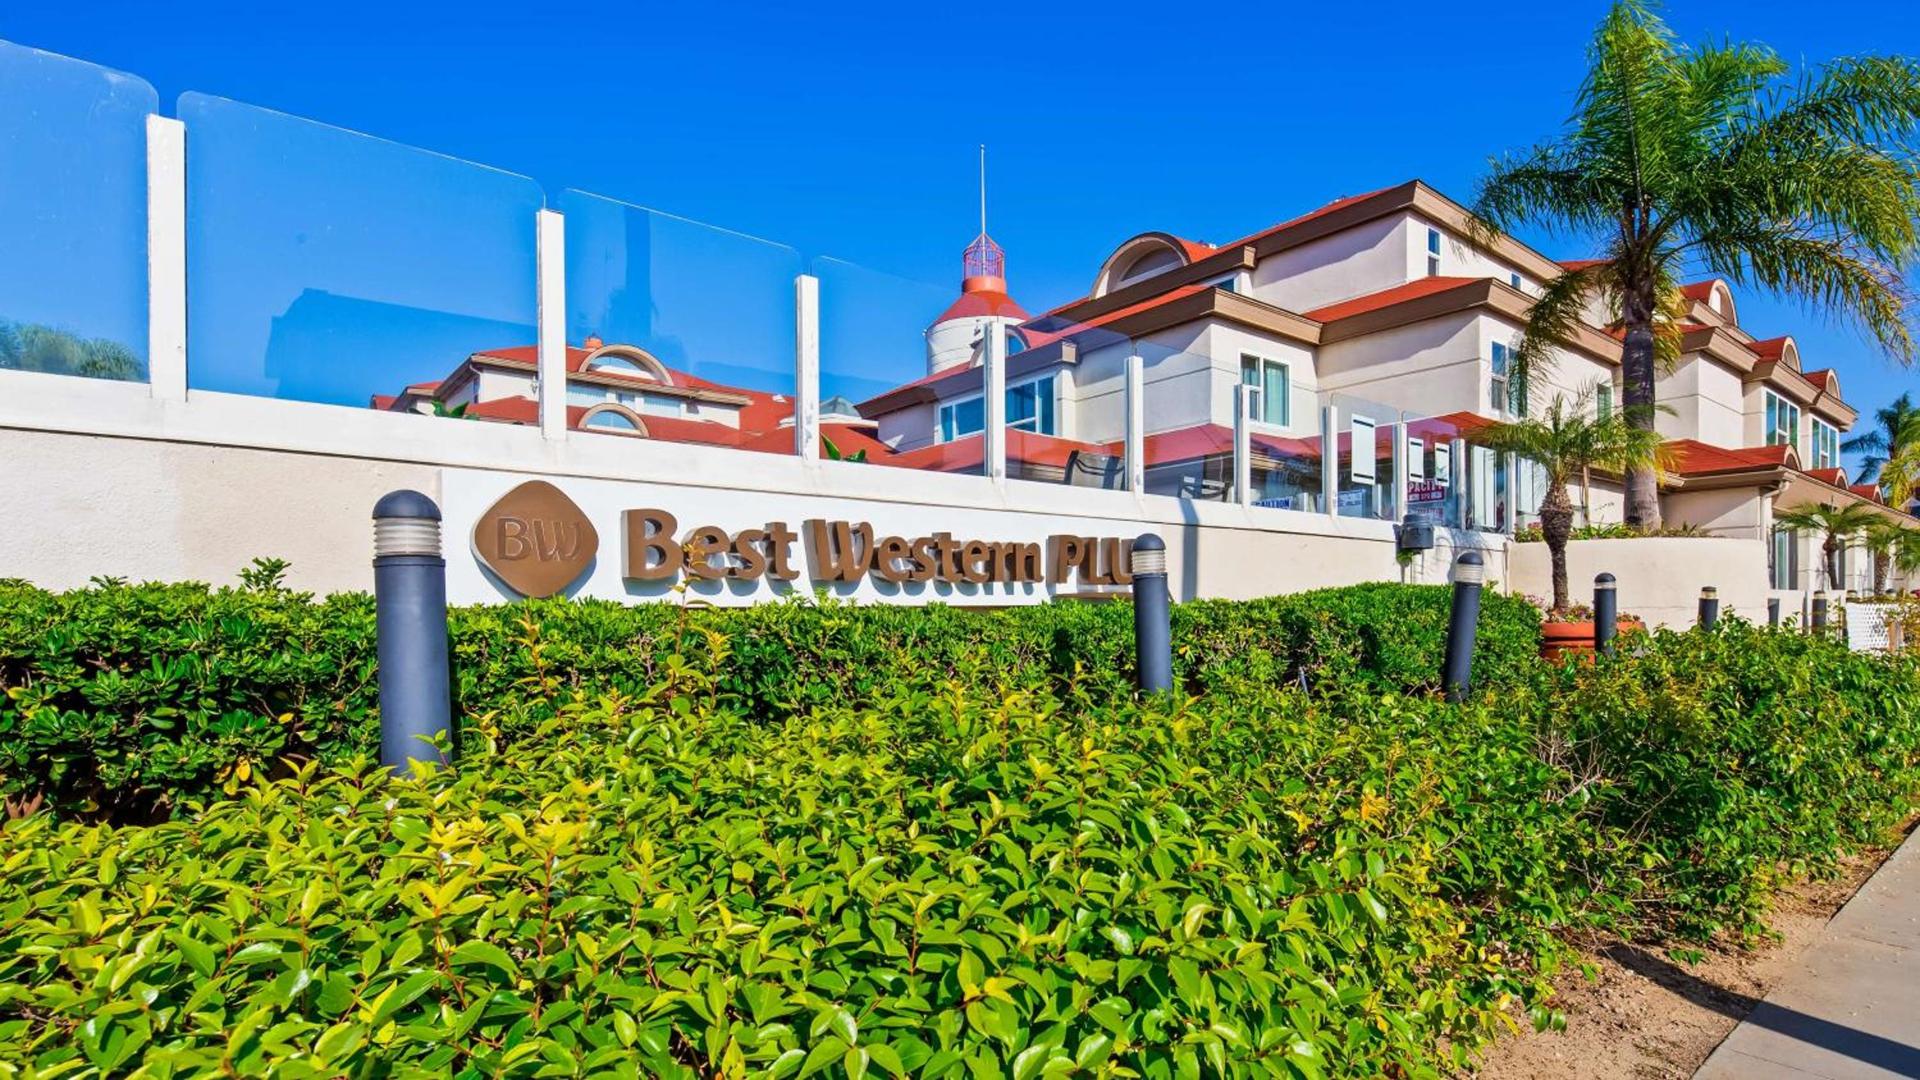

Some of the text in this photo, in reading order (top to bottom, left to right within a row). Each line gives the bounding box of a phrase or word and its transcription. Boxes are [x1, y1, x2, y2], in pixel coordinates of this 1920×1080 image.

[497, 517, 585, 561] BW
[621, 508, 1134, 585] Best Western PLU
